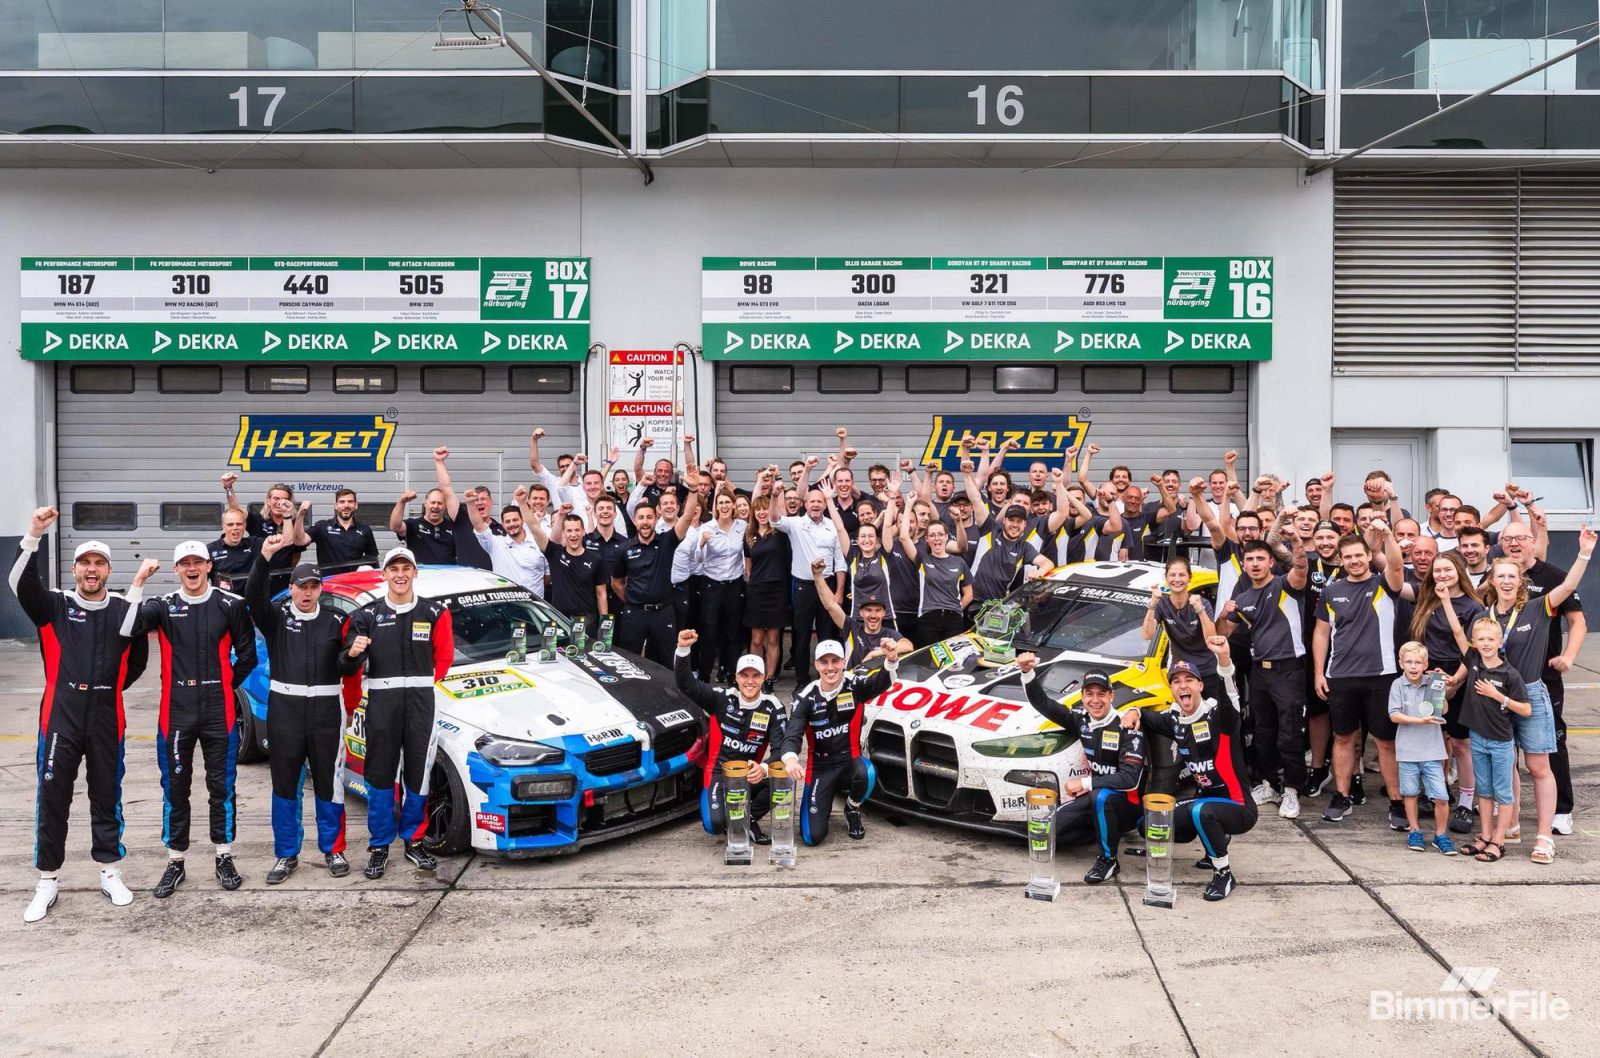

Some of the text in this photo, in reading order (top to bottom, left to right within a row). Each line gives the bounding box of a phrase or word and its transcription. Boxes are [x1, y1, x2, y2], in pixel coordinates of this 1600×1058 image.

[229, 86, 287, 127] 17
[968, 84, 1025, 126] 16
[545, 261, 588, 280] BOX
[1229, 260, 1272, 279] BOX
[58, 274, 96, 295] 187
[172, 274, 210, 295] 310
[283, 274, 329, 295] 440
[399, 274, 444, 295] 505
[743, 274, 773, 295] 98
[851, 273, 896, 294] 300
[970, 273, 1008, 294] 321
[1084, 273, 1125, 294] 776
[483, 300, 527, 309] nürburgring
[548, 284, 589, 319] 17
[1166, 299, 1210, 308] nürburgring
[1228, 282, 1271, 318] 16
[69, 334, 129, 350] DEKRA
[179, 334, 239, 350] DEKRA
[288, 334, 349, 350] DEKRA
[398, 334, 458, 350] DEKRA
[508, 334, 568, 350] DEKRA
[750, 333, 811, 349] DEKRA
[861, 333, 921, 349] DEKRA
[971, 333, 1031, 349] DEKRA
[1081, 333, 1141, 349] DEKRA
[1191, 333, 1251, 349] DEKRA
[627, 354, 667, 362] CAUTION
[622, 405, 672, 413] ACHTUNG
[247, 430, 379, 458] HAZET
[394, 472, 404, 480] 17
[457, 591, 531, 605] GRAN TURISMO
[1081, 588, 1153, 604] GRAN TURISM
[462, 676, 500, 690] 310
[482, 683, 530, 694] DEKRA
[354, 711, 366, 739] 31
[661, 714, 679, 725] H&R
[587, 731, 610, 744] H&R
[815, 723, 849, 740] ROWE
[723, 735, 758, 753] ROWE
[1002, 798, 1025, 809] H&R
[477, 813, 499, 822] auto
